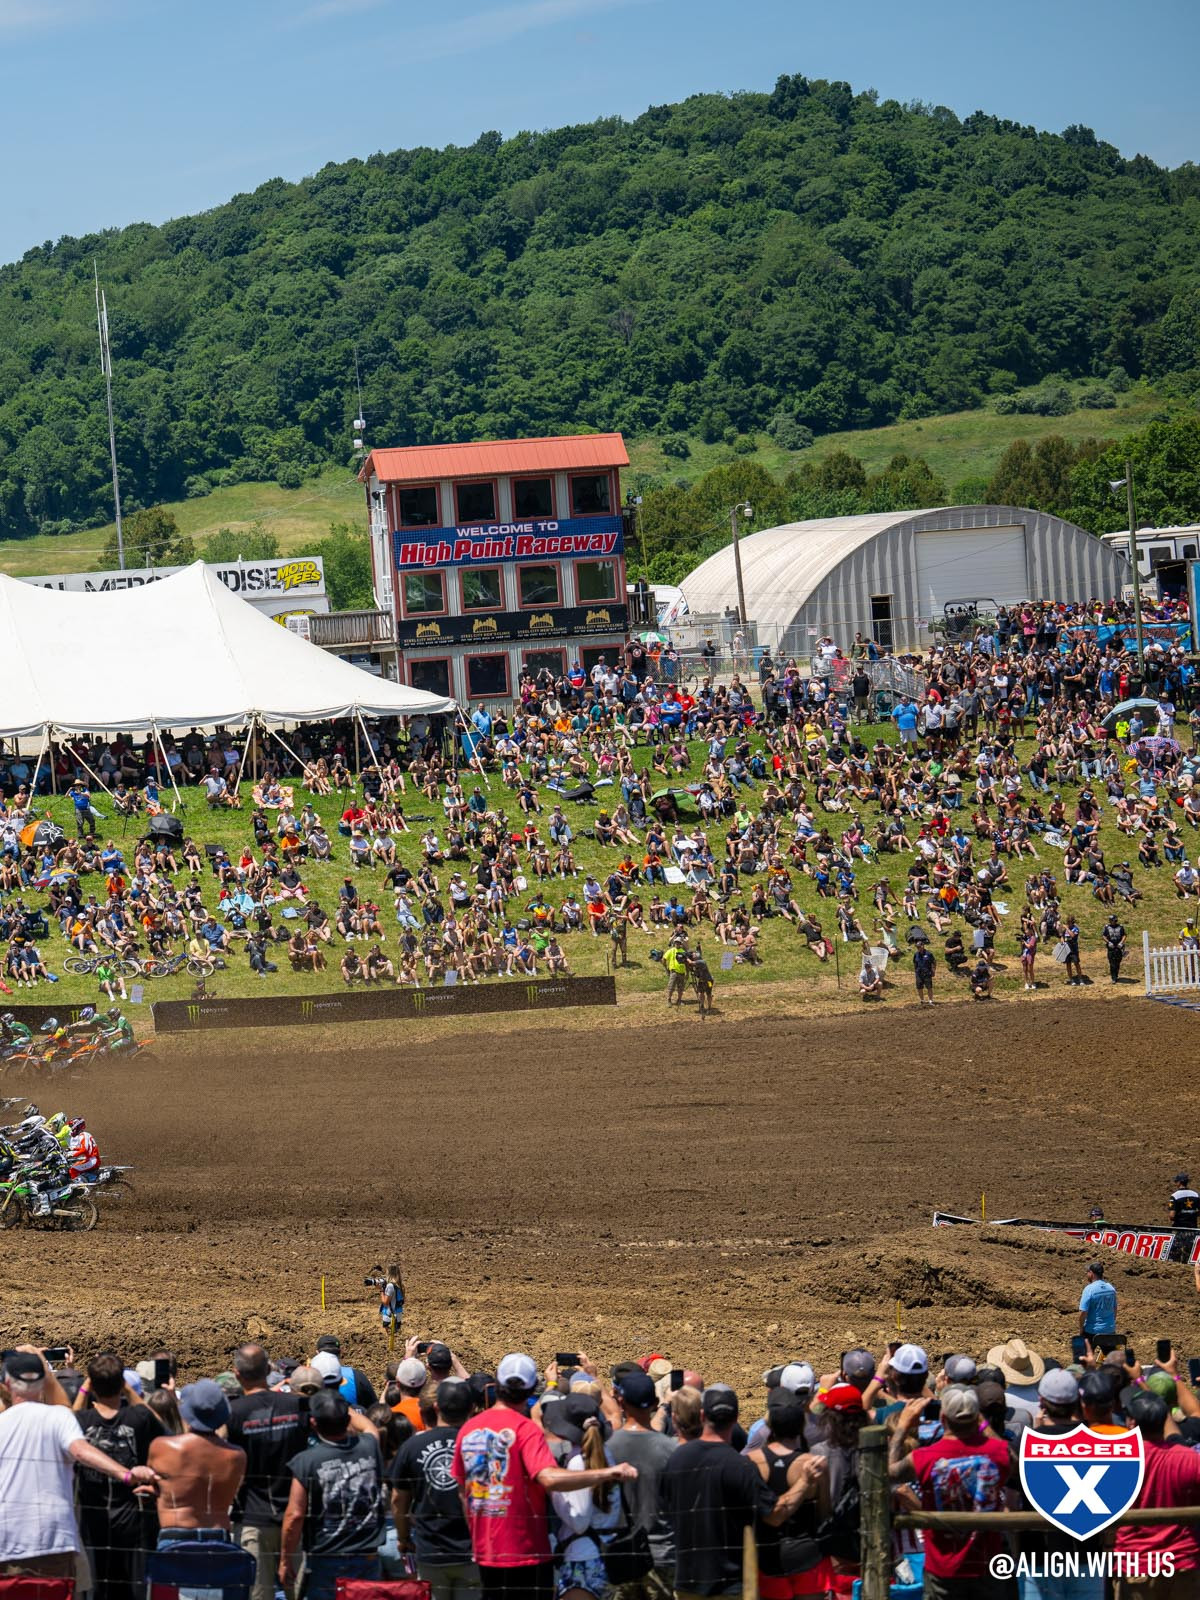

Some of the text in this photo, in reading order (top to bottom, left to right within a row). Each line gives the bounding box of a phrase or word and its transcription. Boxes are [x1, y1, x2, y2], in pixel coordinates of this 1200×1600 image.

[456, 522, 558, 537] WELCOME TO
[399, 532, 618, 566] High Point Raceway
[280, 561, 316, 581] MOTO
[282, 571, 321, 592] TEES
[416, 1440, 443, 1464] LAKE
